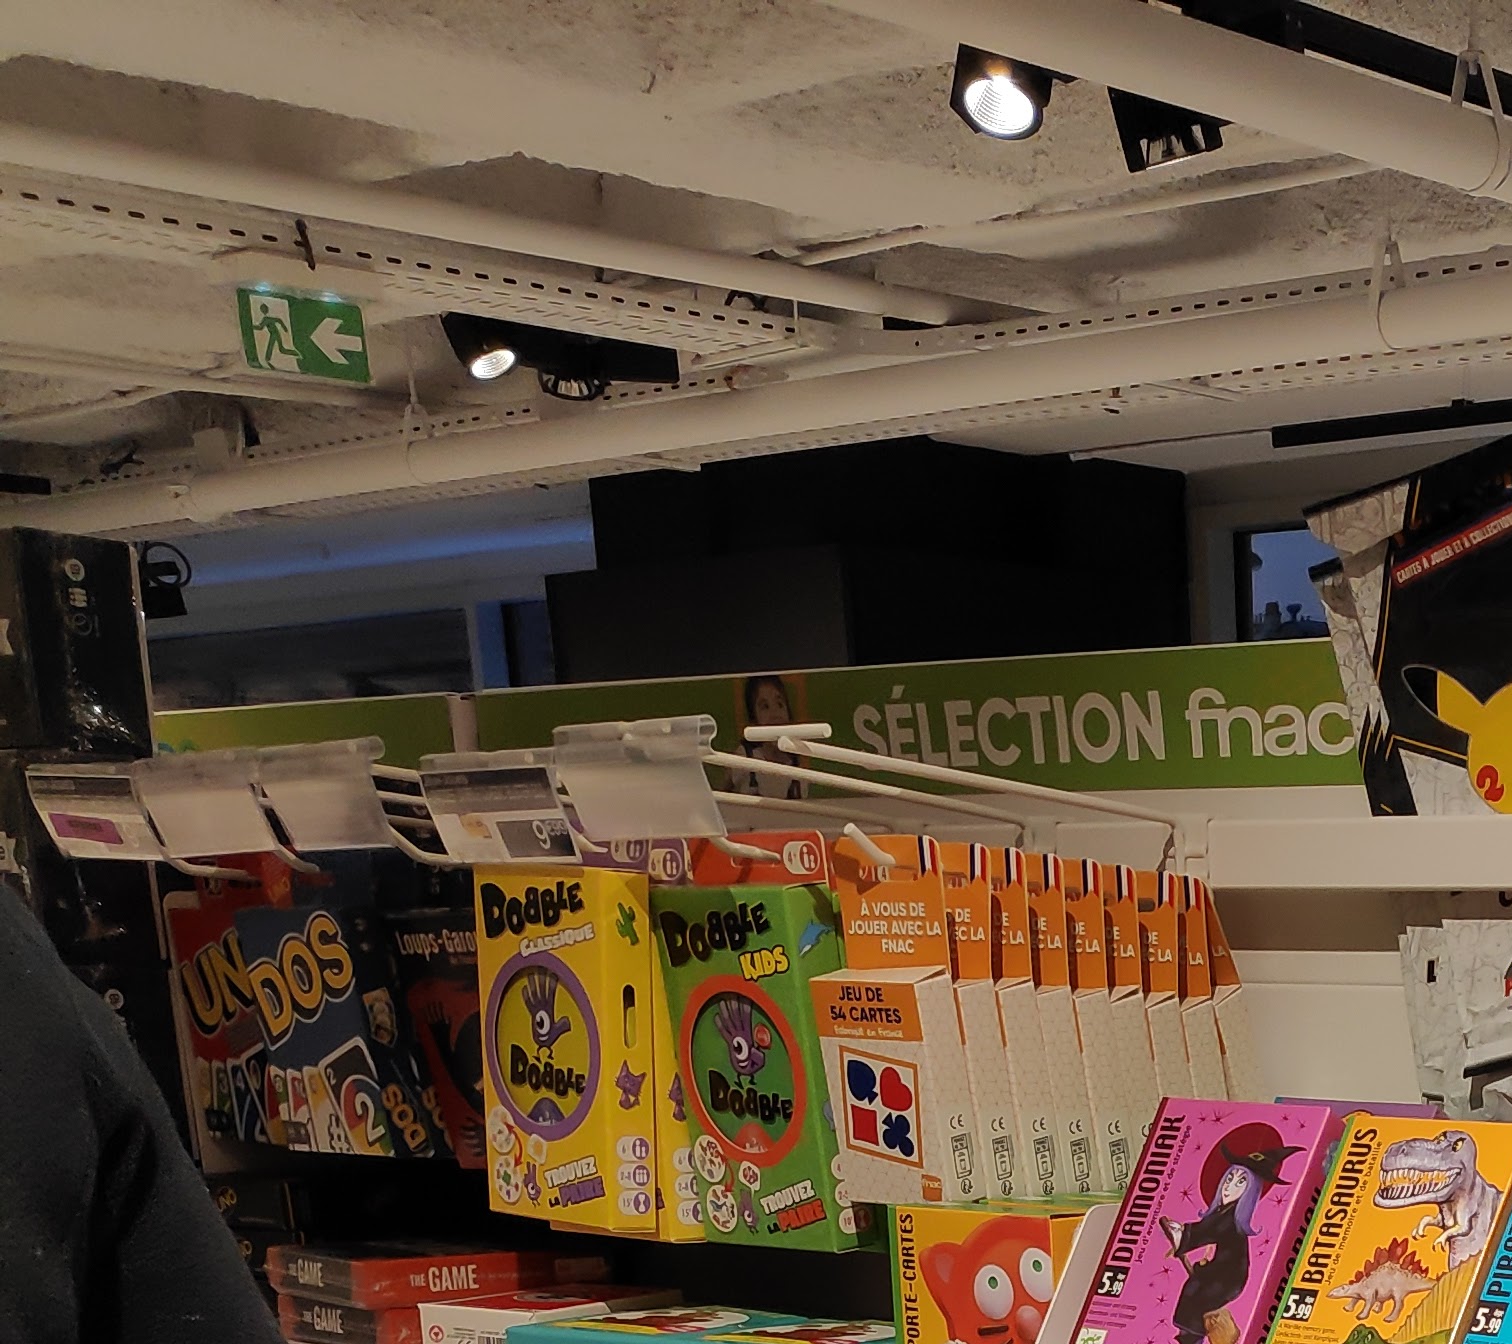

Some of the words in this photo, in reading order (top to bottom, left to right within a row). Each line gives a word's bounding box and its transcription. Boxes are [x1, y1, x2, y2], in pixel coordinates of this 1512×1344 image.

[852, 684, 1167, 769] SÉLECTION
[1185, 687, 1356, 758] fnac
[873, 900, 904, 918] VOUS
[907, 902, 927, 918] DE
[519, 922, 595, 957] CLASSIQUE
[848, 918, 889, 936] JOUER
[890, 920, 924, 937] AVEC
[925, 921, 943, 937] LA
[880, 936, 916, 955] FNAC
[247, 910, 355, 1050] DOS
[738, 945, 791, 983] KIDS
[837, 985, 860, 1003] JEU
[863, 986, 885, 1004] DE
[829, 1004, 848, 1024] 54
[849, 1005, 903, 1025] CARTES
[544, 1155, 598, 1189] TROUVEZ
[761, 1179, 817, 1216] TROUVEZ
[1111, 1114, 1186, 1265] DIAMONIAK
[1300, 1127, 1379, 1286] BATASAURUS
[296, 1257, 325, 1288] GAME
[427, 1263, 480, 1293] GAME
[312, 1306, 344, 1335] GAME
